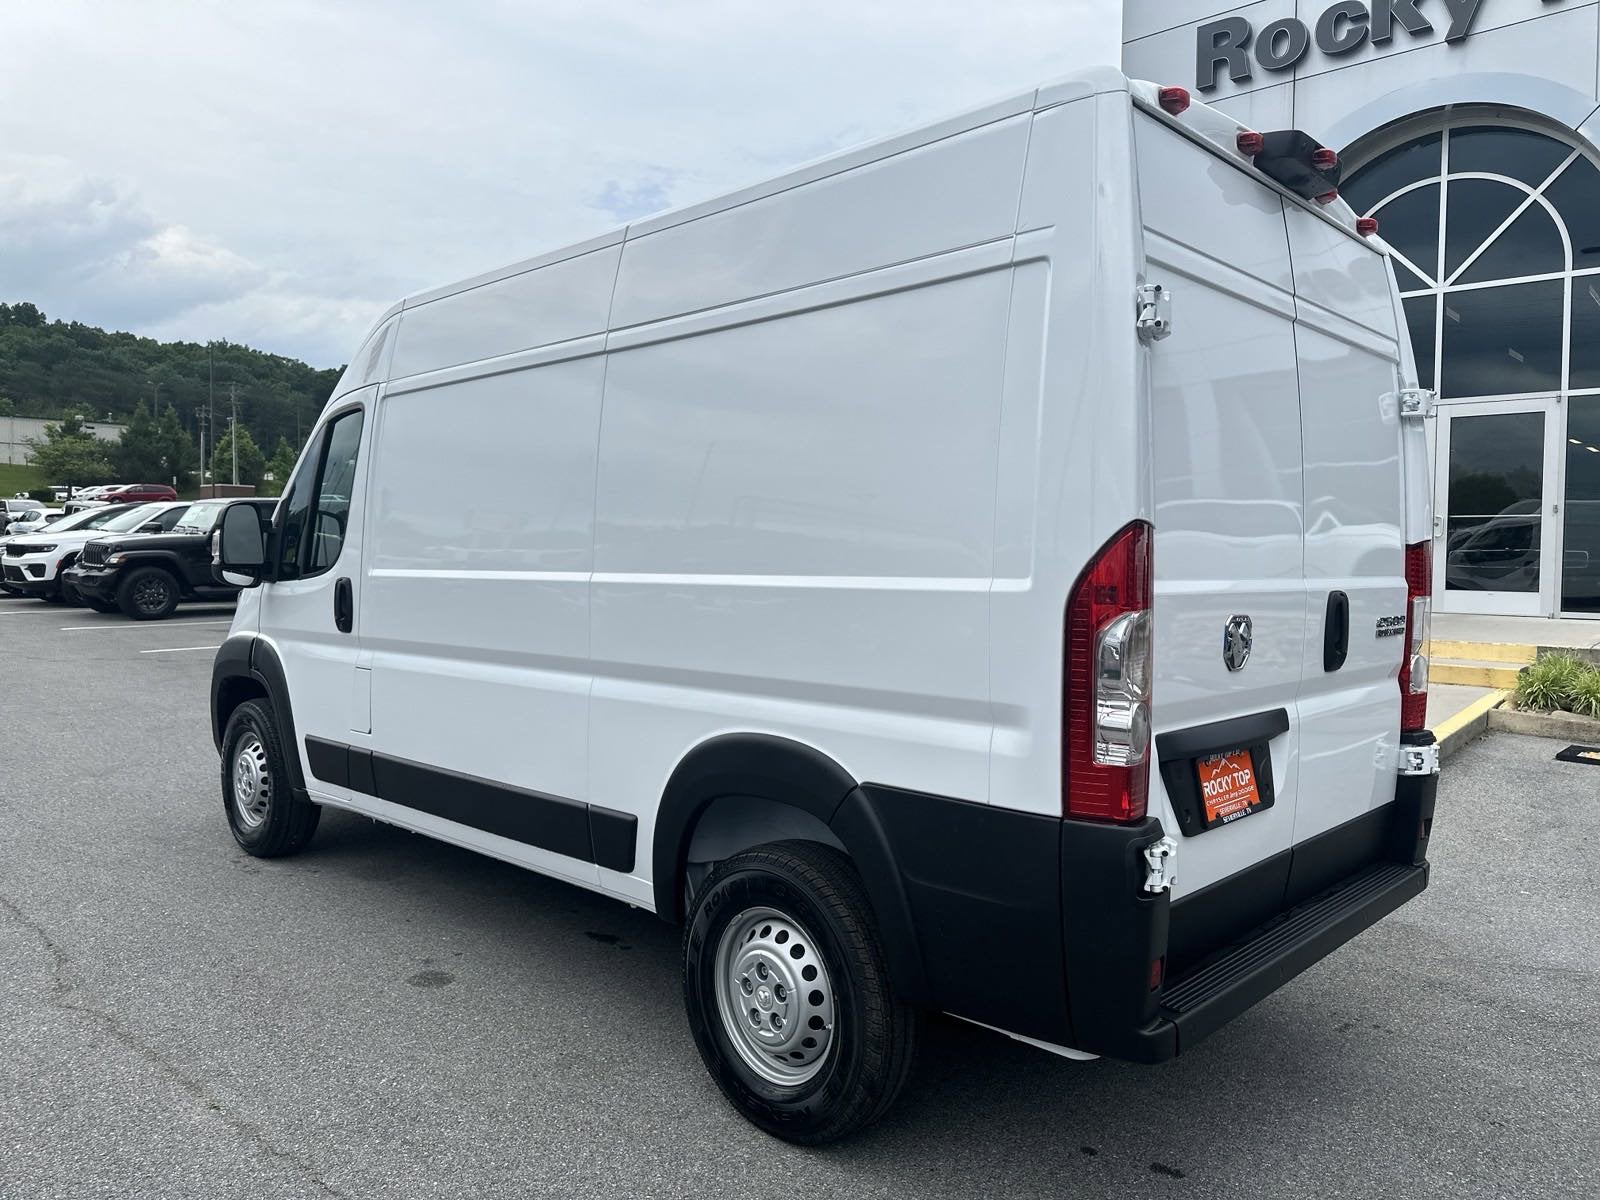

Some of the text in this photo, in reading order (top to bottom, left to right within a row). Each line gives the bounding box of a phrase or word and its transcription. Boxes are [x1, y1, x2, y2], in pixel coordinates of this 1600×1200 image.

[1196, 0, 1481, 91] Rocky
[1375, 615, 1405, 628] 2500
[1203, 769, 1251, 797] ROCKY TOP
[1206, 795, 1229, 806] CHRYSLER
[1238, 785, 1254, 795] DODGE
